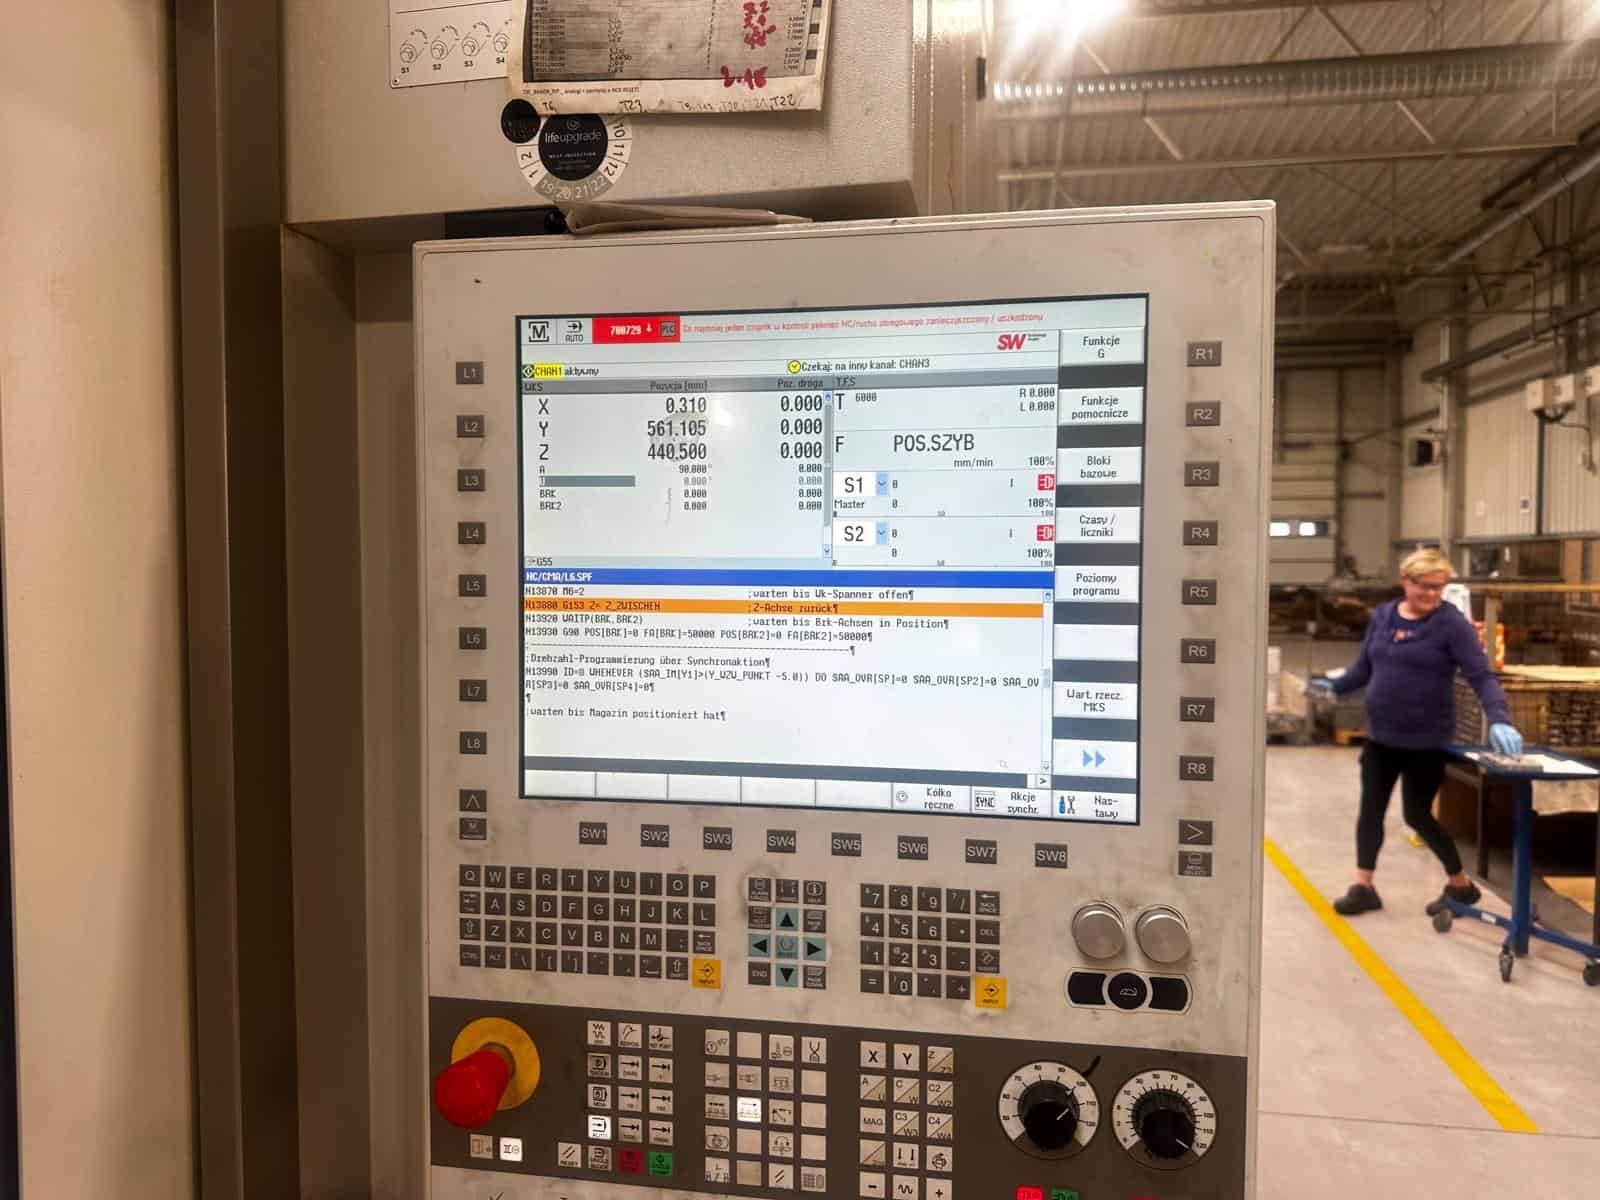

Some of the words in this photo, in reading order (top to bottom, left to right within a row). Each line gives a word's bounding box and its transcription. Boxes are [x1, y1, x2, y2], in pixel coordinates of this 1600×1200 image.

[613, 123, 625, 138] 10
[521, 151, 533, 160] 2
[612, 144, 624, 156] 11
[528, 169, 539, 178] 1
[603, 161, 618, 177] 12
[532, 325, 546, 338] M
[565, 335, 584, 343] AUTO
[997, 334, 1026, 350] SW
[1082, 335, 1121, 347] Funkcje
[1097, 348, 1105, 359] G
[1195, 347, 1214, 361] R1
[835, 362, 847, 371] na
[899, 358, 930, 369] CHAN3
[463, 367, 476, 379] L1
[534, 366, 563, 377] CHAN1
[1019, 388, 1027, 398] R
[1029, 386, 1055, 398] 0.000
[538, 398, 549, 415] X
[665, 397, 707, 414] 0.310
[780, 395, 823, 412] 0.000
[835, 393, 845, 410] T
[855, 392, 877, 403] 6000
[1019, 402, 1026, 412] L
[1028, 401, 1055, 412] 0.000
[1081, 395, 1119, 407] Funkcje
[1071, 408, 1129, 420] pomocnicze
[1193, 407, 1213, 420] R2
[464, 421, 479, 433] L2
[538, 421, 549, 437] Y
[647, 420, 706, 437] 561.105
[780, 418, 823, 435] 0.000
[835, 435, 845, 453] F
[893, 433, 975, 453] POS.SZYB
[539, 443, 549, 460] Z
[647, 443, 707, 460] 440.500
[780, 441, 823, 459] 0.000
[953, 457, 993, 468] mm/min
[1028, 456, 1055, 467] 100%
[1087, 455, 1111, 466] Bloki
[1191, 468, 1212, 481] R3
[464, 475, 480, 487] L3
[844, 476, 864, 494] S1
[539, 489, 557, 499] BRK
[539, 501, 563, 511] BRK2
[834, 498, 865, 510] Master
[1027, 498, 1054, 508] 100%
[1079, 514, 1108, 526] Czasy
[465, 527, 480, 539] L4
[844, 525, 865, 542] S2
[1080, 527, 1114, 538] liczniki
[1191, 527, 1210, 539] R4
[1026, 548, 1053, 559] 100%
[1076, 572, 1117, 584] Poziomy
[466, 580, 481, 592] L5
[1072, 585, 1120, 597] programu
[1189, 585, 1209, 598] R5
[562, 587, 585, 596] M6=2
[793, 589, 810, 598] bis
[562, 600, 585, 610] G153
[793, 617, 810, 627] bis
[879, 618, 891, 628] in
[562, 628, 580, 637] G90
[466, 633, 481, 645] L6
[1188, 644, 1208, 657] R6
[660, 655, 682, 666] über
[815, 672, 827, 682] DO
[467, 685, 481, 697] L7
[1083, 702, 1106, 713] MKS
[1186, 704, 1206, 716] R7
[568, 708, 585, 717] bis
[589, 708, 628, 719] Magazin
[632, 709, 698, 720] positioniert
[466, 737, 481, 749] L8
[1187, 762, 1207, 775] R8
[975, 796, 996, 809] SYNC
[1010, 791, 1037, 804] Akcje
[923, 800, 955, 812] ręczne
[1007, 804, 1040, 816] synchr.
[580, 828, 608, 841] SW1
[642, 829, 670, 842] SW2
[704, 832, 733, 845] SW3
[767, 835, 795, 847] SW4
[832, 838, 861, 851] SW5
[899, 841, 928, 855] SW6
[967, 845, 996, 858] SW7
[1036, 849, 1066, 863] SW8
[464, 871, 476, 882] Q
[488, 872, 502, 883] W
[516, 872, 526, 884] E
[541, 874, 552, 885] R
[567, 875, 577, 887] T
[868, 1049, 879, 1063] X
[902, 1052, 913, 1065] Y
[928, 1084, 941, 1093] C2
[863, 1117, 884, 1126] MAG
[895, 1112, 908, 1121] C3
[928, 1116, 941, 1125] C4
